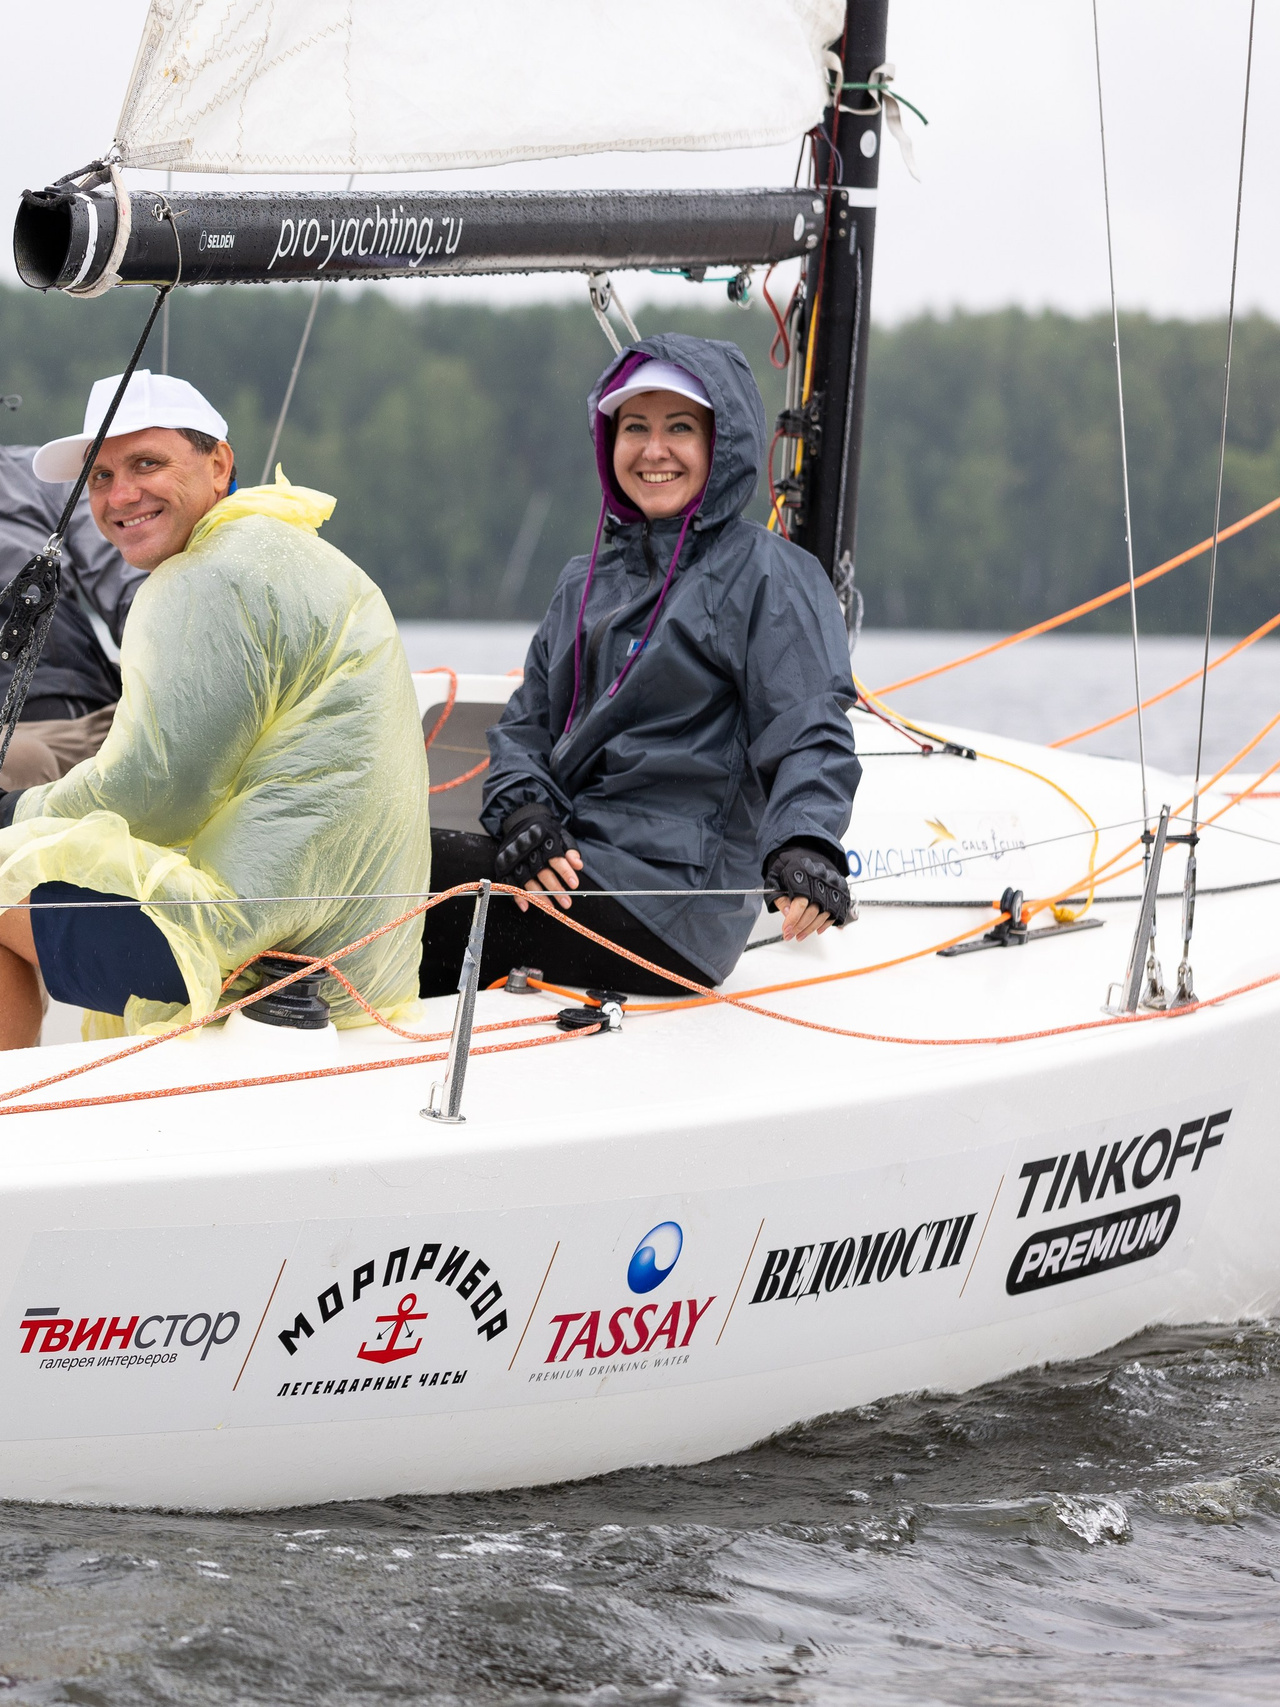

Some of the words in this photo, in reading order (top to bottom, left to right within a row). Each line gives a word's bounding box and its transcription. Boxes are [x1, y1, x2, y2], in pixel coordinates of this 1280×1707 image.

[207, 231, 235, 249] SELDÉN
[267, 205, 463, 270] pro-yachting.ru
[1017, 1108, 1233, 1219] TINKOFF
[748, 1212, 978, 1306] ВЕДОМОСТИ
[1015, 1206, 1173, 1283] PREMIUM
[278, 1243, 508, 1356] МОРПРИБОР
[544, 1296, 717, 1364] TASSAY
[39, 1356, 95, 1371] галерея
[97, 1353, 178, 1369] интерьеров
[277, 1375, 412, 1397] ЛЕГЕНДАРНЫЕ
[418, 1370, 468, 1387] ЧАСЫ
[528, 1367, 584, 1382] PREMIUM
[588, 1360, 648, 1376] DRINKING
[653, 1354, 690, 1368] WATER
